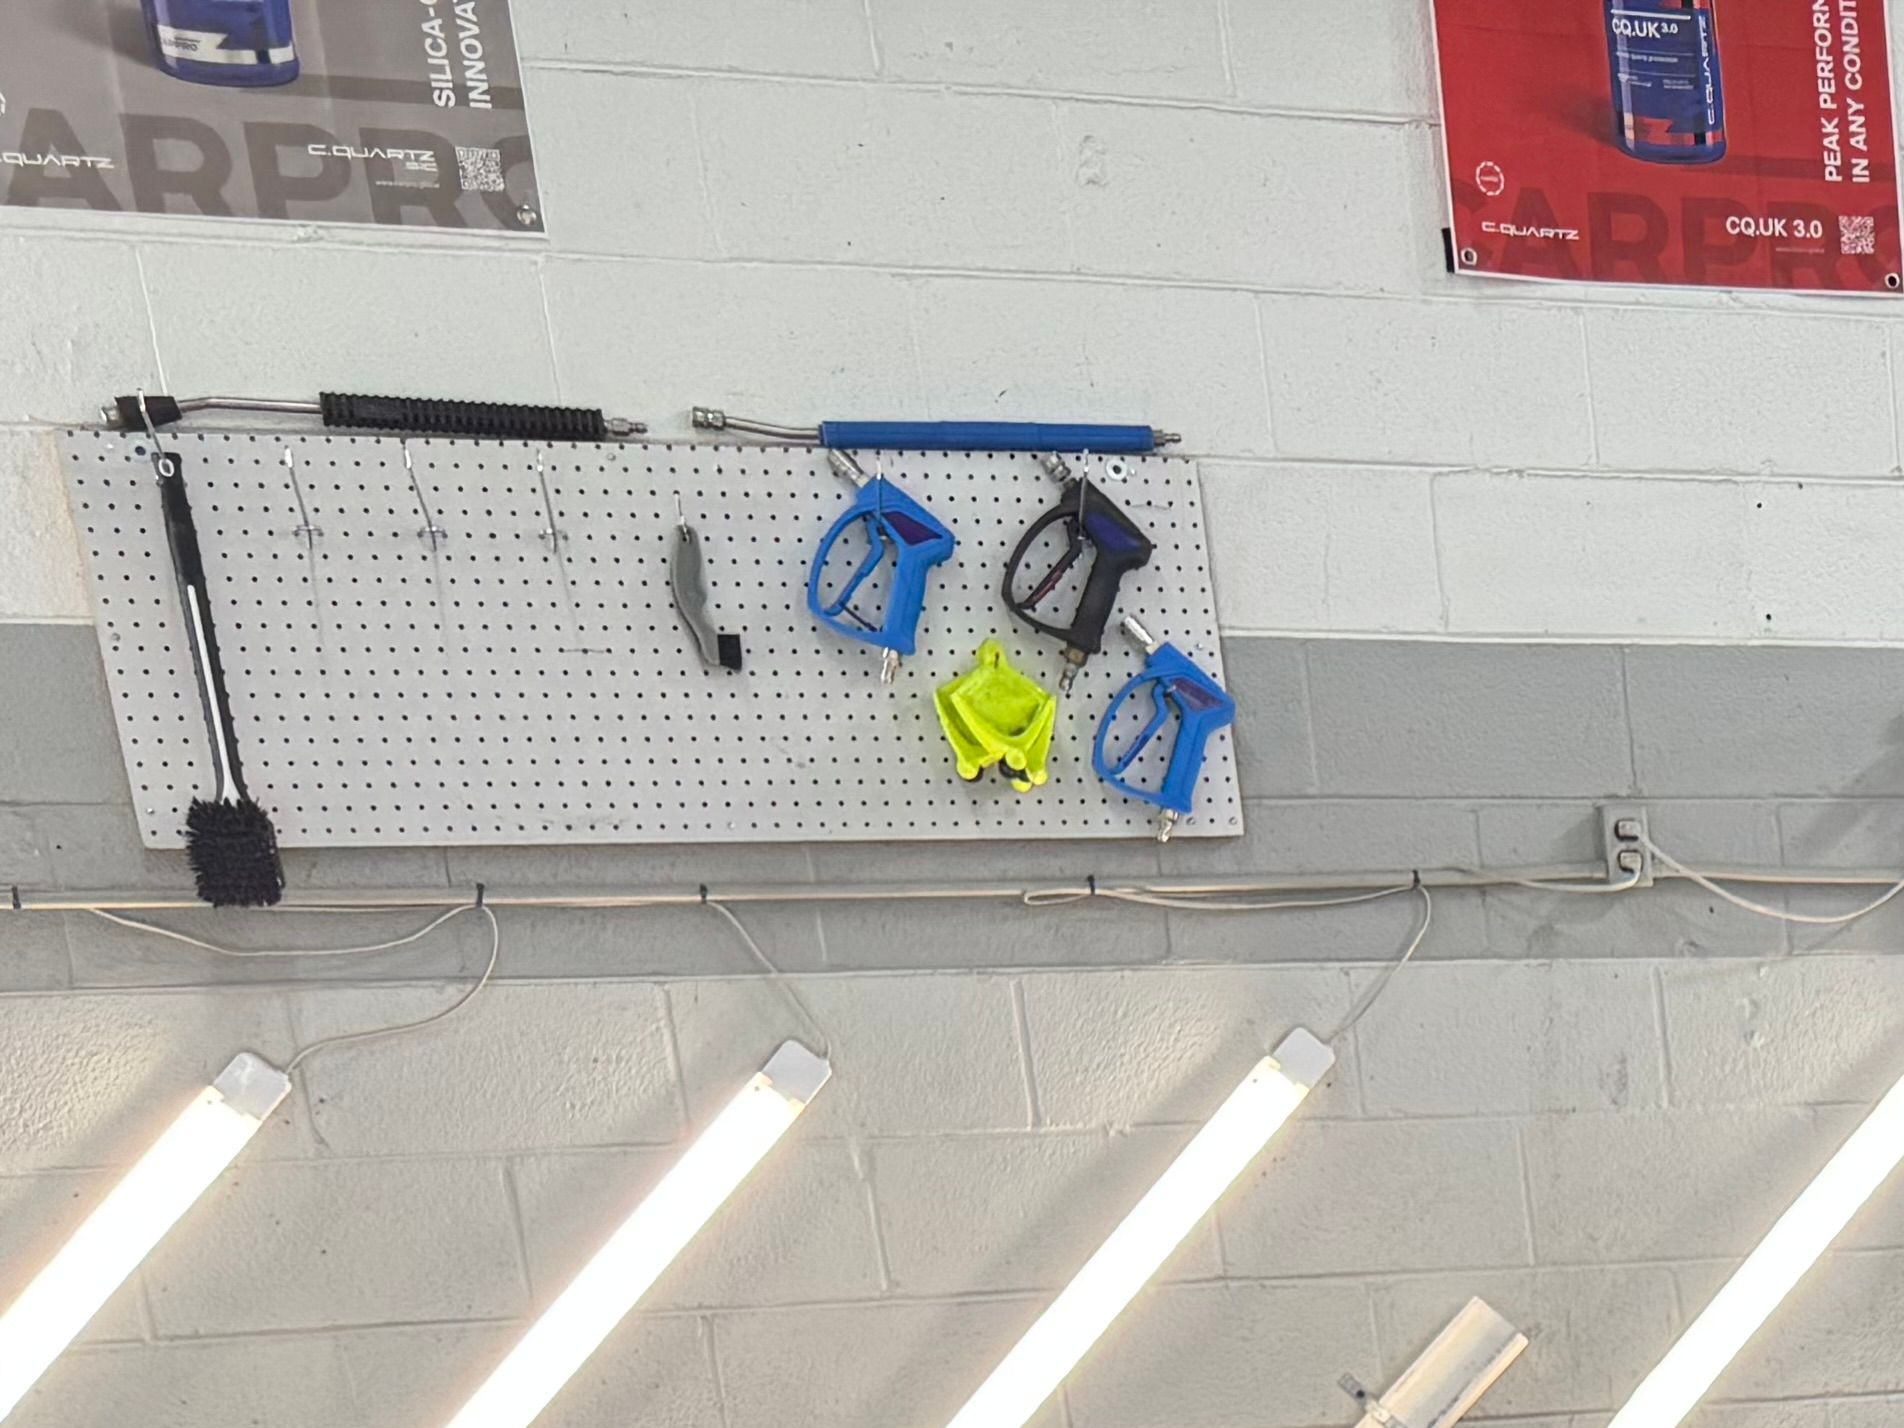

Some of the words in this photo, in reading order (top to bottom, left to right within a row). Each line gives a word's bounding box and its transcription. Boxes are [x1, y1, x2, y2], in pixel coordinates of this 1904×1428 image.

[420, 0, 456, 108] SILICA-
[453, 0, 492, 109] INNOVA
[1847, 98, 1868, 151] ANY
[0, 151, 115, 169] QUARTZ
[307, 144, 434, 161] C.QUARTZ
[1821, 117, 1842, 182] PEAK
[1852, 159, 1871, 183] IN
[1481, 221, 1579, 240] C.QUARTZ
[1726, 216, 1787, 237] CQ.UK
[1793, 219, 1823, 239] 3.0
